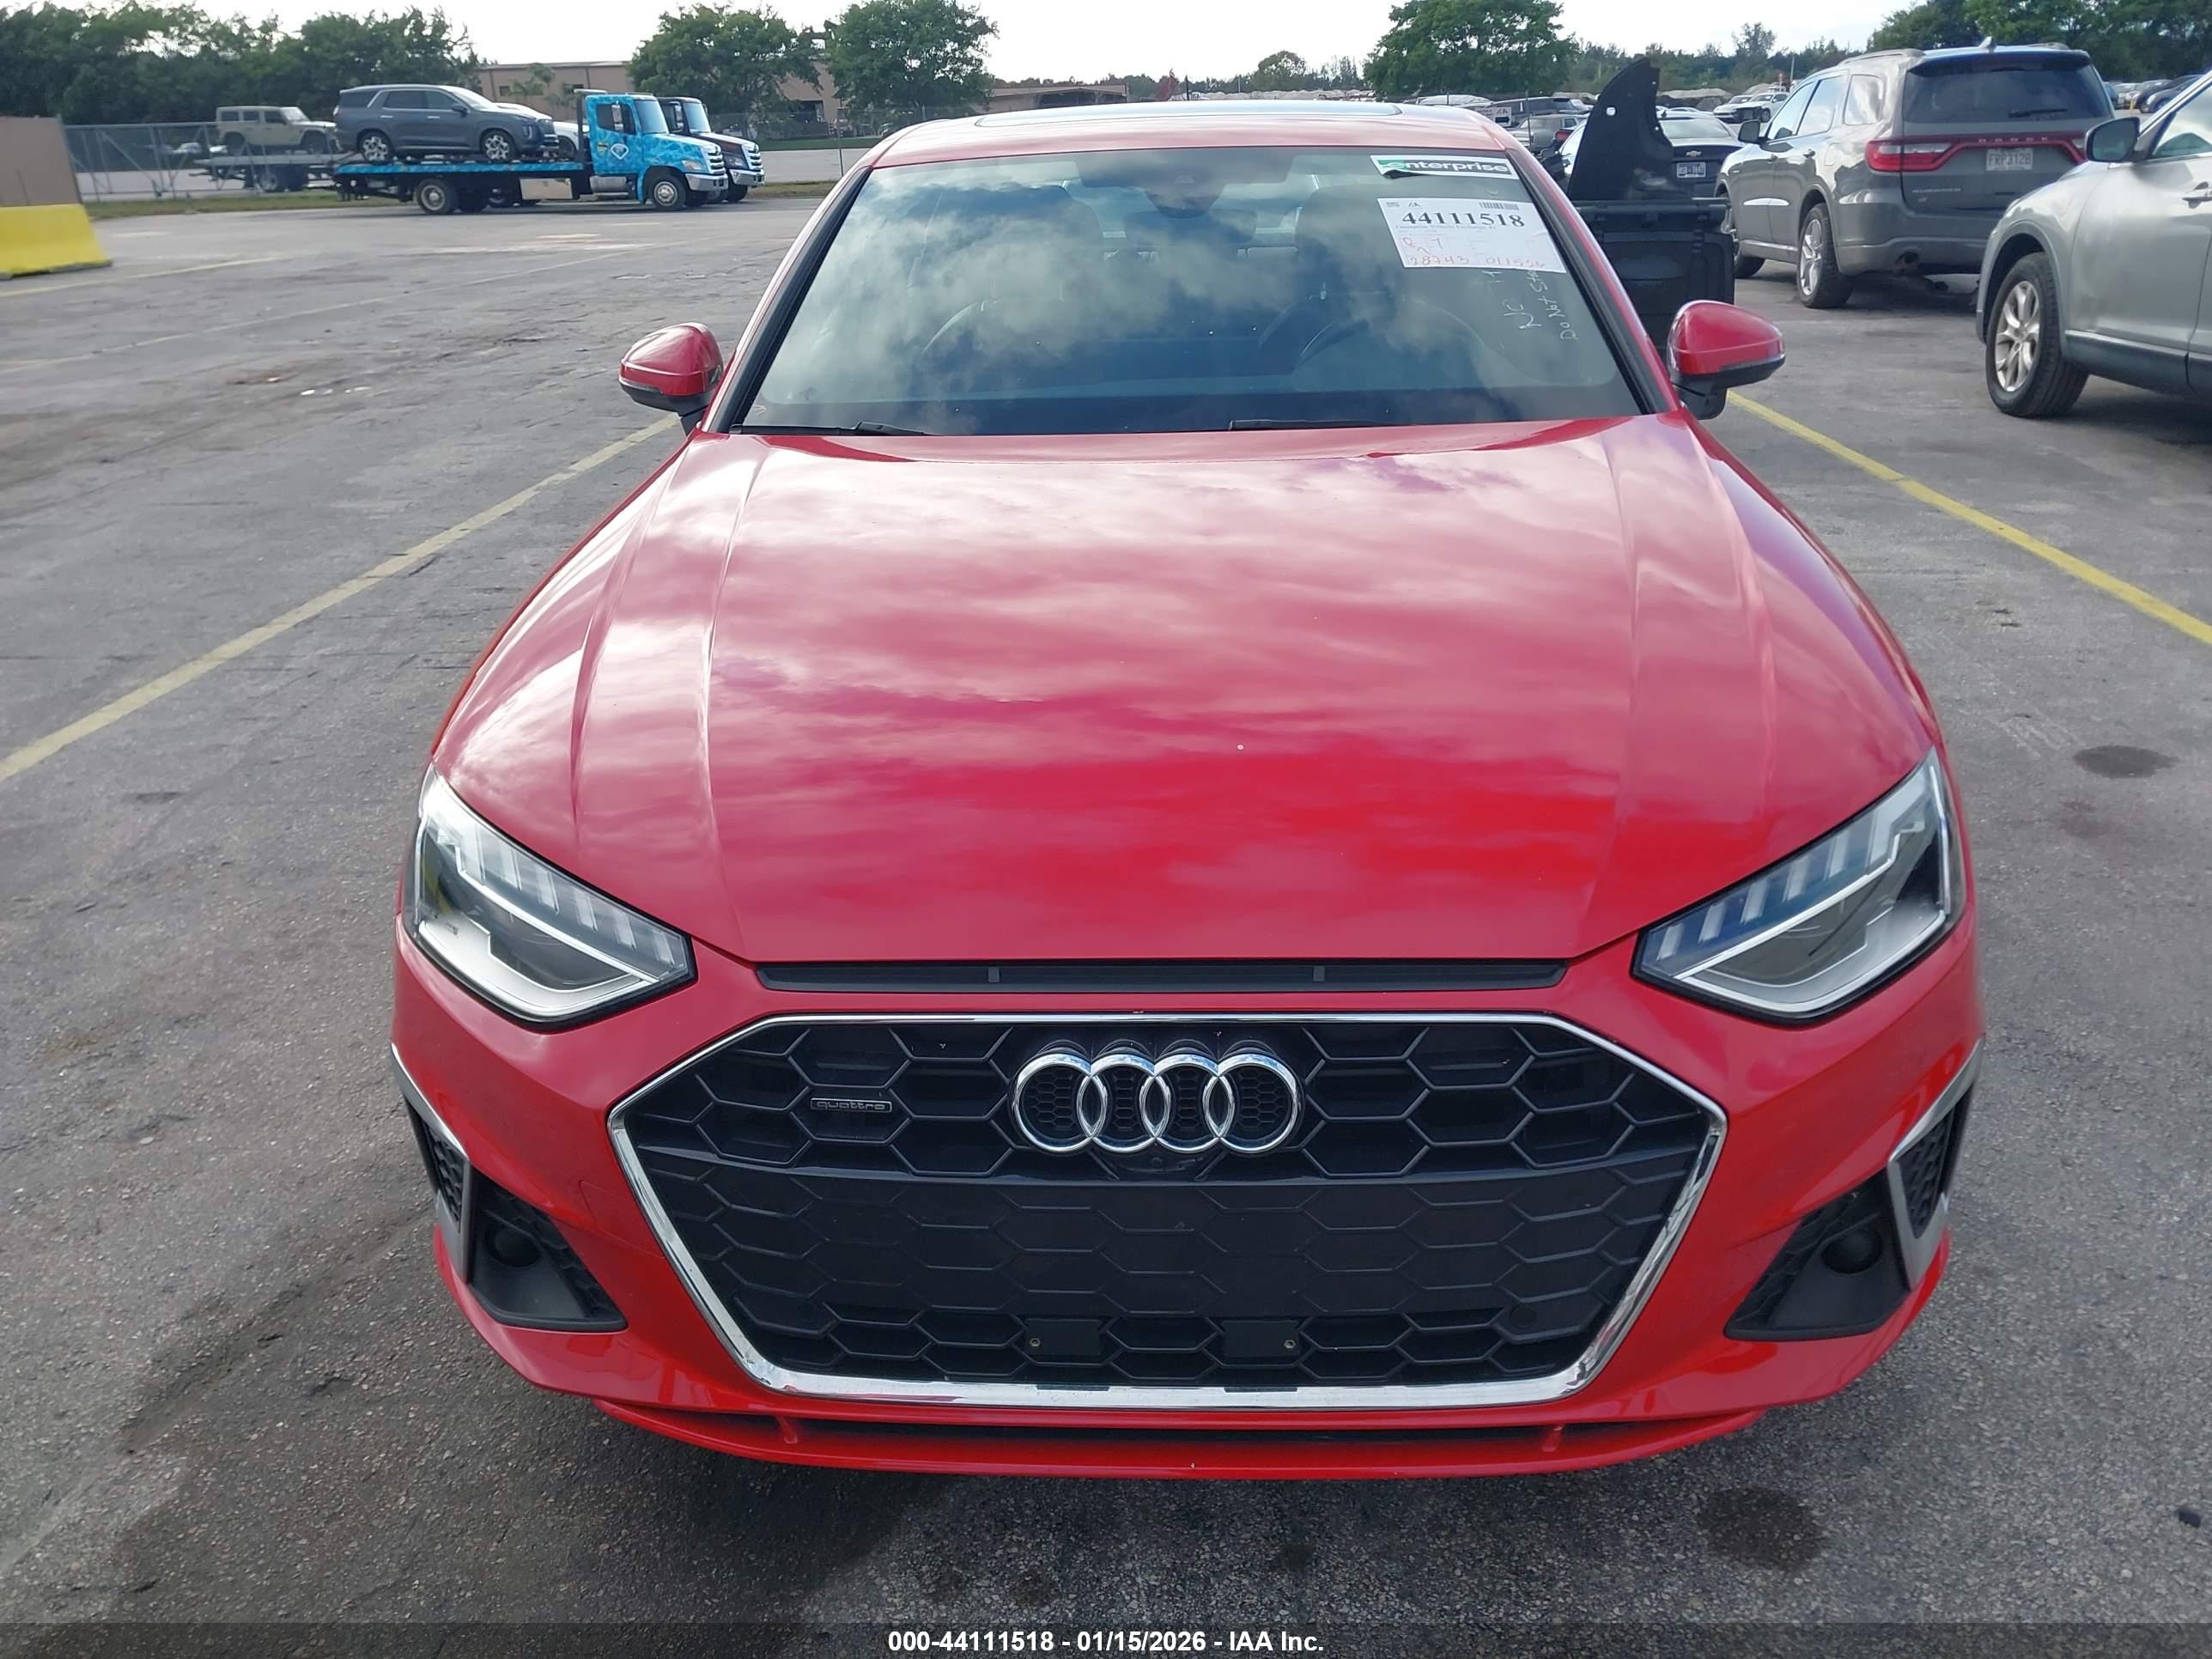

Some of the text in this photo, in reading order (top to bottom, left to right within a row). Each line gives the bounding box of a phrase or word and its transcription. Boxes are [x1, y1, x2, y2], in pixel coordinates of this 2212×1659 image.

[1387, 161, 1507, 172] enterprise
[1401, 211, 1525, 228] 44111518
[817, 1101, 885, 1110] quattro
